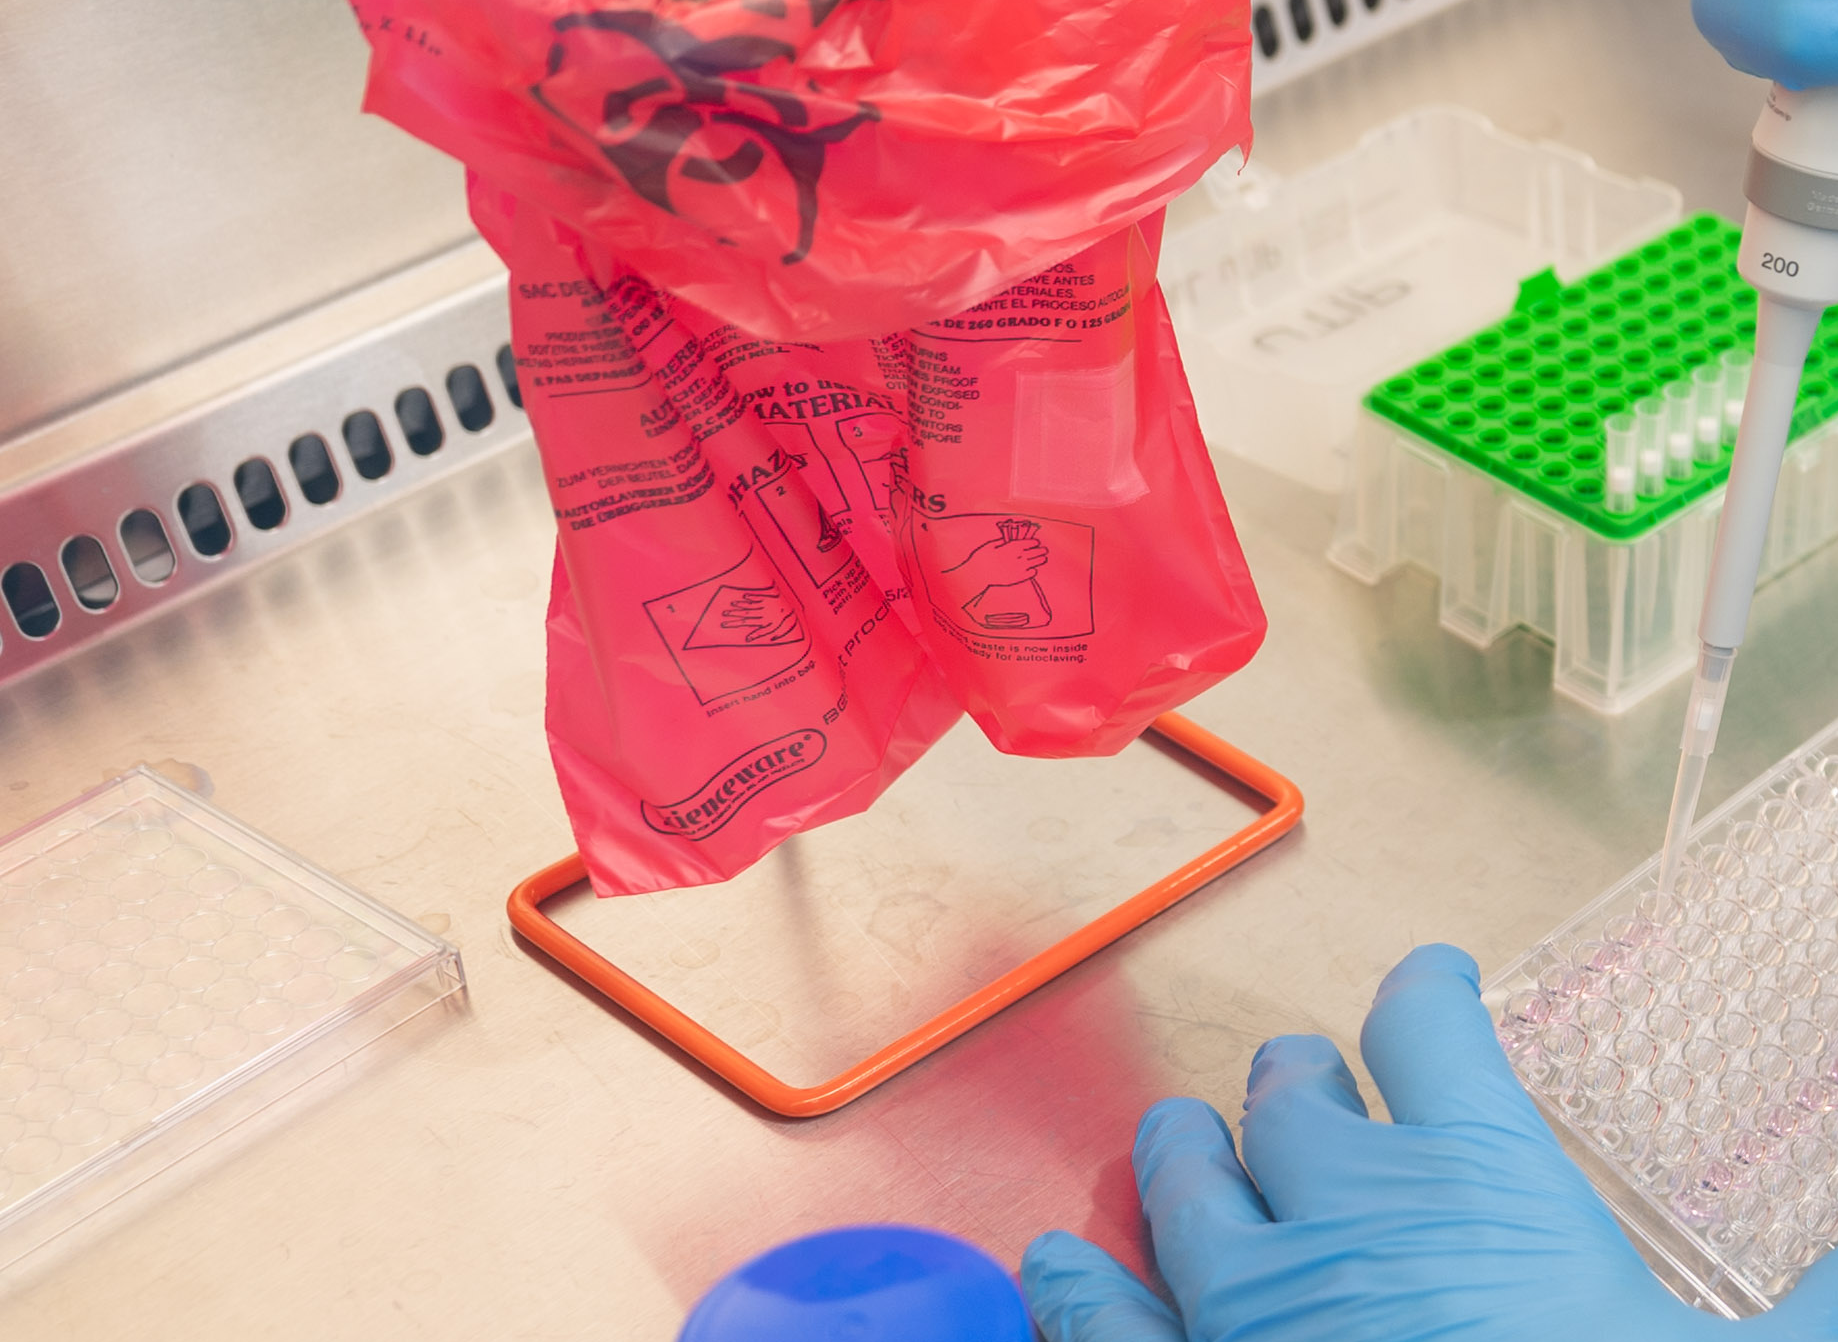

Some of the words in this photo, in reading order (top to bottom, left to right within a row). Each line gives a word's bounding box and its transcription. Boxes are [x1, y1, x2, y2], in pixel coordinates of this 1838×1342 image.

[1761, 252, 1800, 278] 200
[1053, 274, 1095, 286] ANTES
[1012, 299, 1028, 309] EL
[1032, 299, 1097, 311] PROCESO
[944, 319, 965, 330] DE
[968, 319, 993, 330] 260
[997, 317, 1051, 328] GRADO
[1055, 318, 1063, 328] F
[1081, 317, 1103, 330] 125
[933, 374, 979, 388] PROOF
[784, 381, 809, 397] to
[921, 383, 981, 401] EXPOSED
[928, 404, 946, 420] TO
[852, 426, 864, 438] 3
[920, 428, 963, 444] SPORE
[557, 471, 586, 489] ZUM
[775, 485, 787, 497] 2
[1010, 642, 1019, 652] is
[1024, 644, 1048, 653] now
[1053, 643, 1088, 653] inside
[1016, 653, 1088, 664] autoclaving.
[774, 674, 797, 691] into
